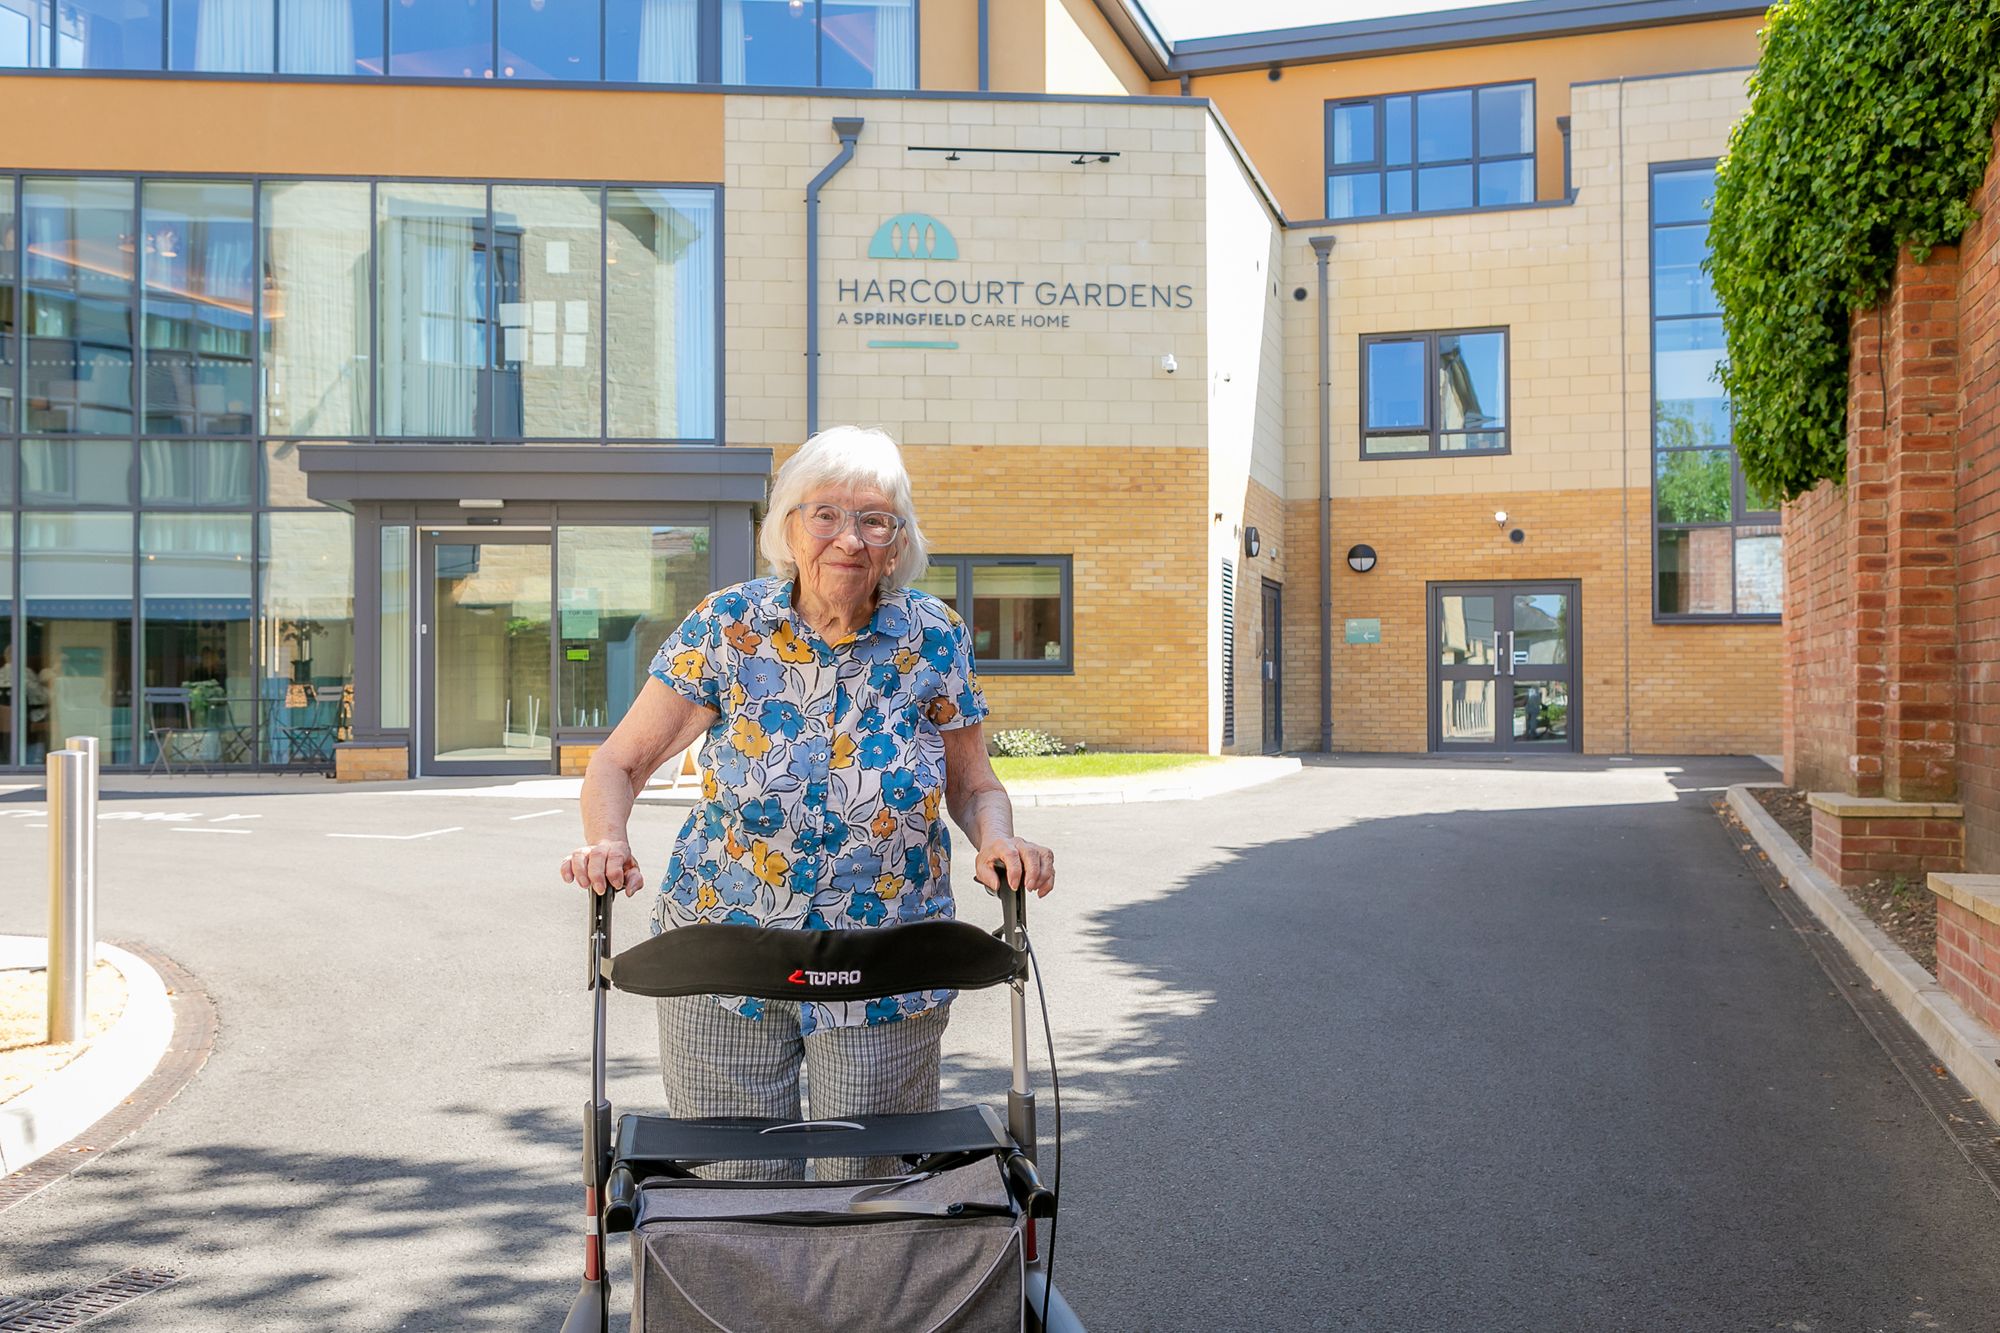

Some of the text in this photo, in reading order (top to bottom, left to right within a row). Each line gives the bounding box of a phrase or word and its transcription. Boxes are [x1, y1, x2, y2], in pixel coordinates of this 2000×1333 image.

[839, 278, 1193, 309] HARCOURT GARDENS
[837, 312, 1070, 328] A SPRINGFIELD CARE HOME
[804, 970, 861, 986] TOPRO
